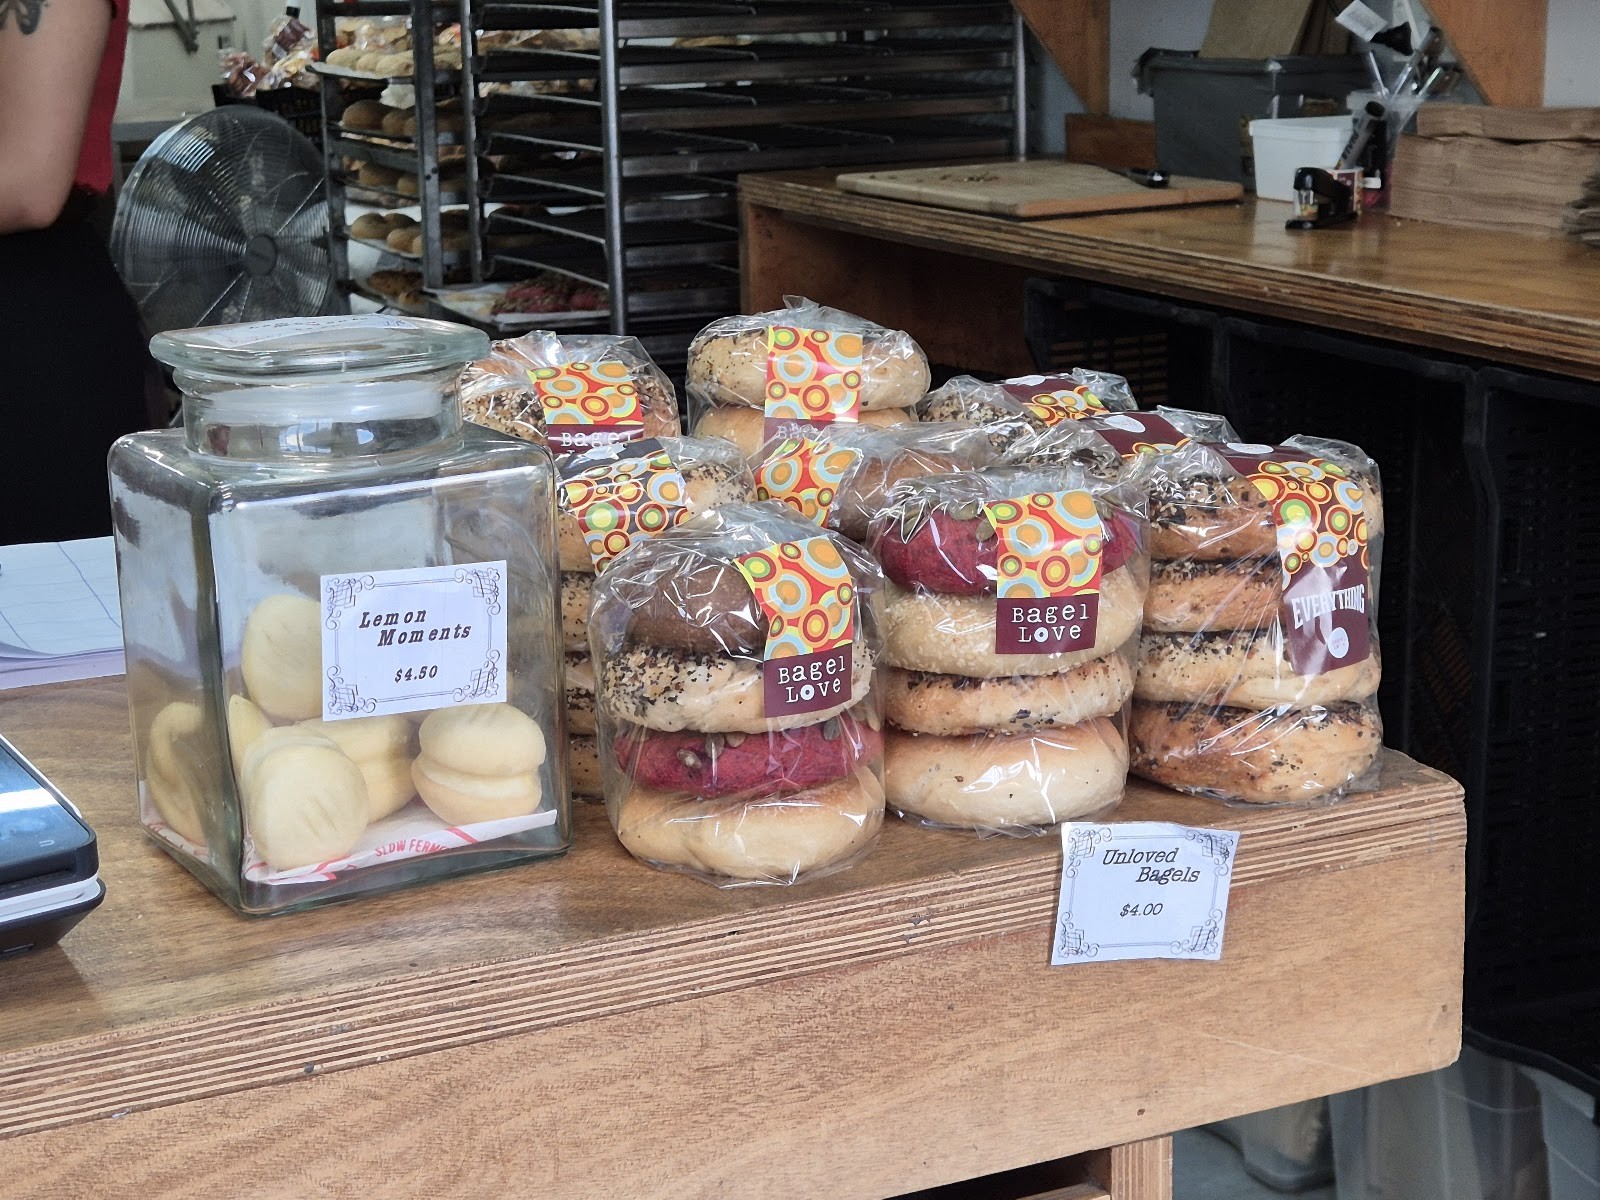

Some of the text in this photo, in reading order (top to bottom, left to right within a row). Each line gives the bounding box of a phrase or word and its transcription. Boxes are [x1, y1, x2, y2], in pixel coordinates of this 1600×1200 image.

[1011, 603, 1089, 624] Bagel
[1291, 584, 1365, 630] EVERYTHING
[359, 609, 427, 628] Lemon
[377, 624, 471, 647] Moments
[394, 665, 438, 683] $4.50
[778, 656, 846, 685] Bagel
[1102, 848, 1180, 866] Unloved
[1135, 867, 1201, 885] Bagels
[1120, 903, 1164, 918] $4.00
